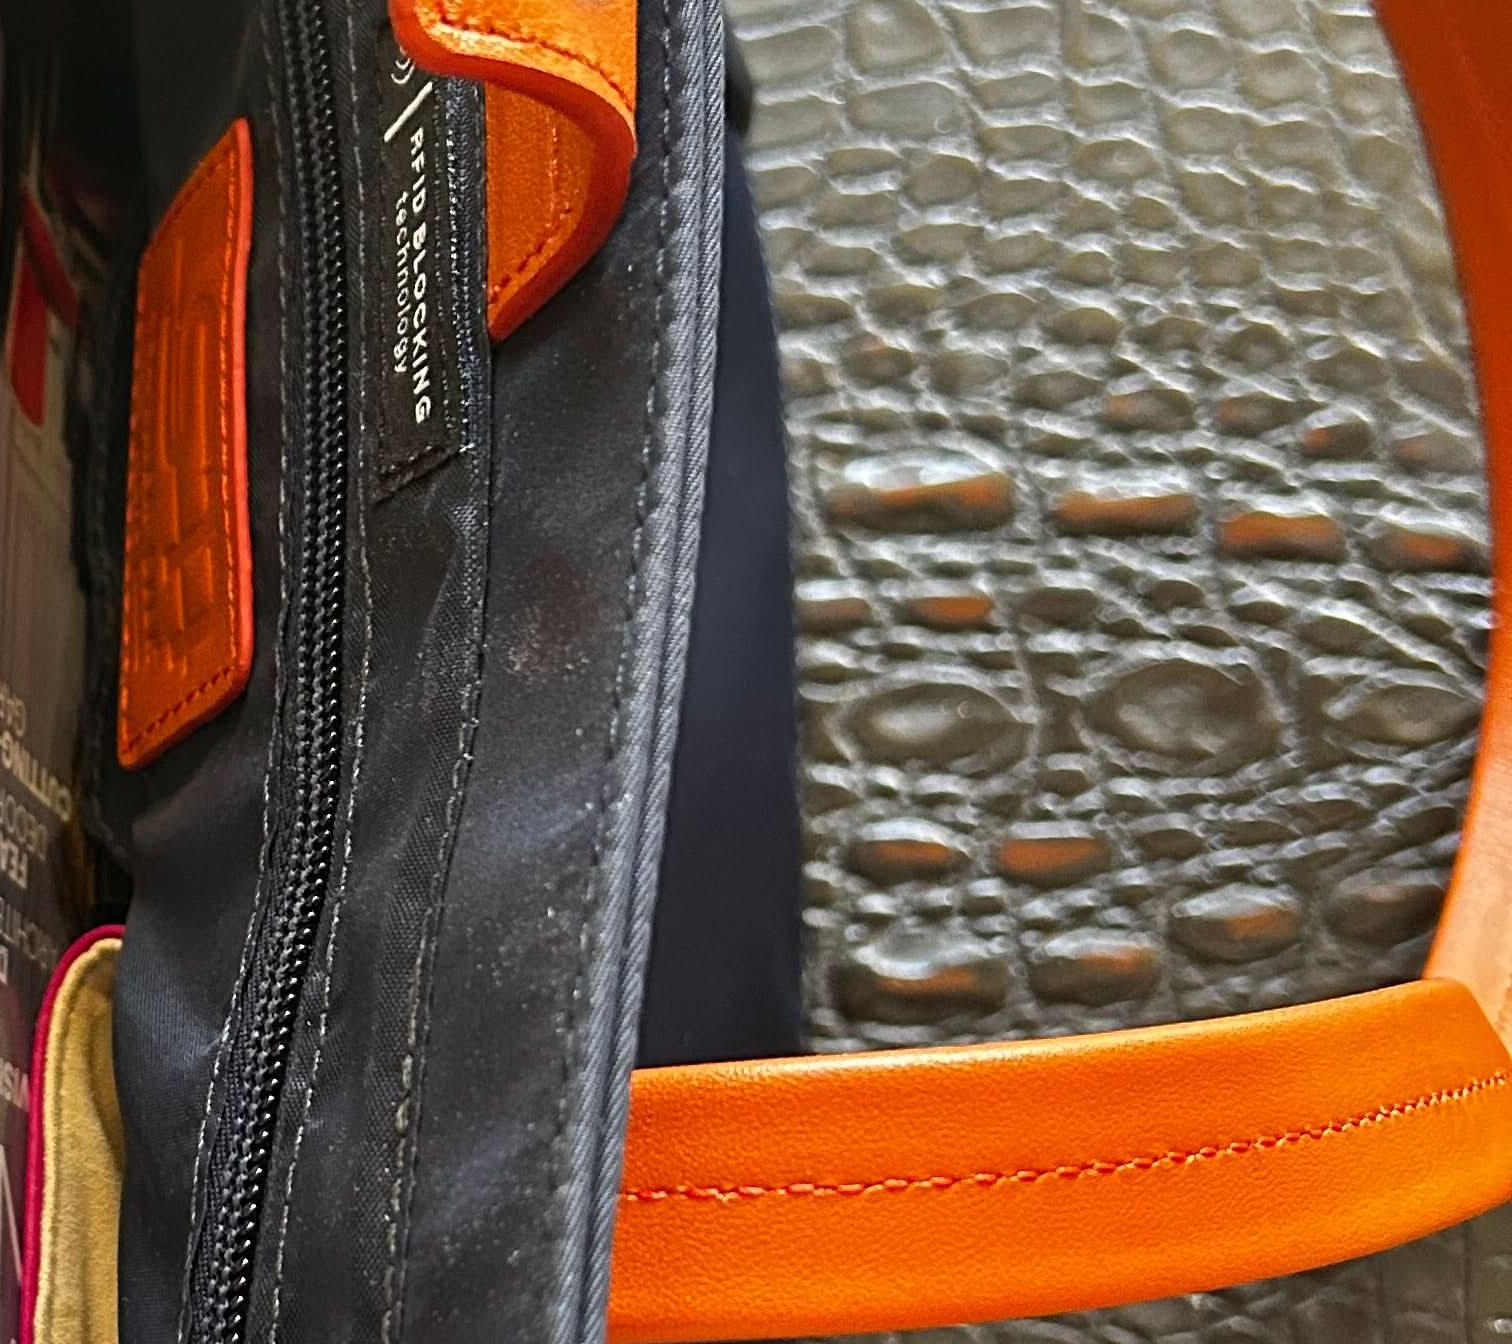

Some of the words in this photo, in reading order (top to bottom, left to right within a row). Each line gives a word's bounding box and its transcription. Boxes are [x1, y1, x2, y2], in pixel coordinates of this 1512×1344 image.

[410, 126, 426, 215] RFID
[392, 188, 411, 376] technology
[412, 221, 432, 425] BLOCKING
